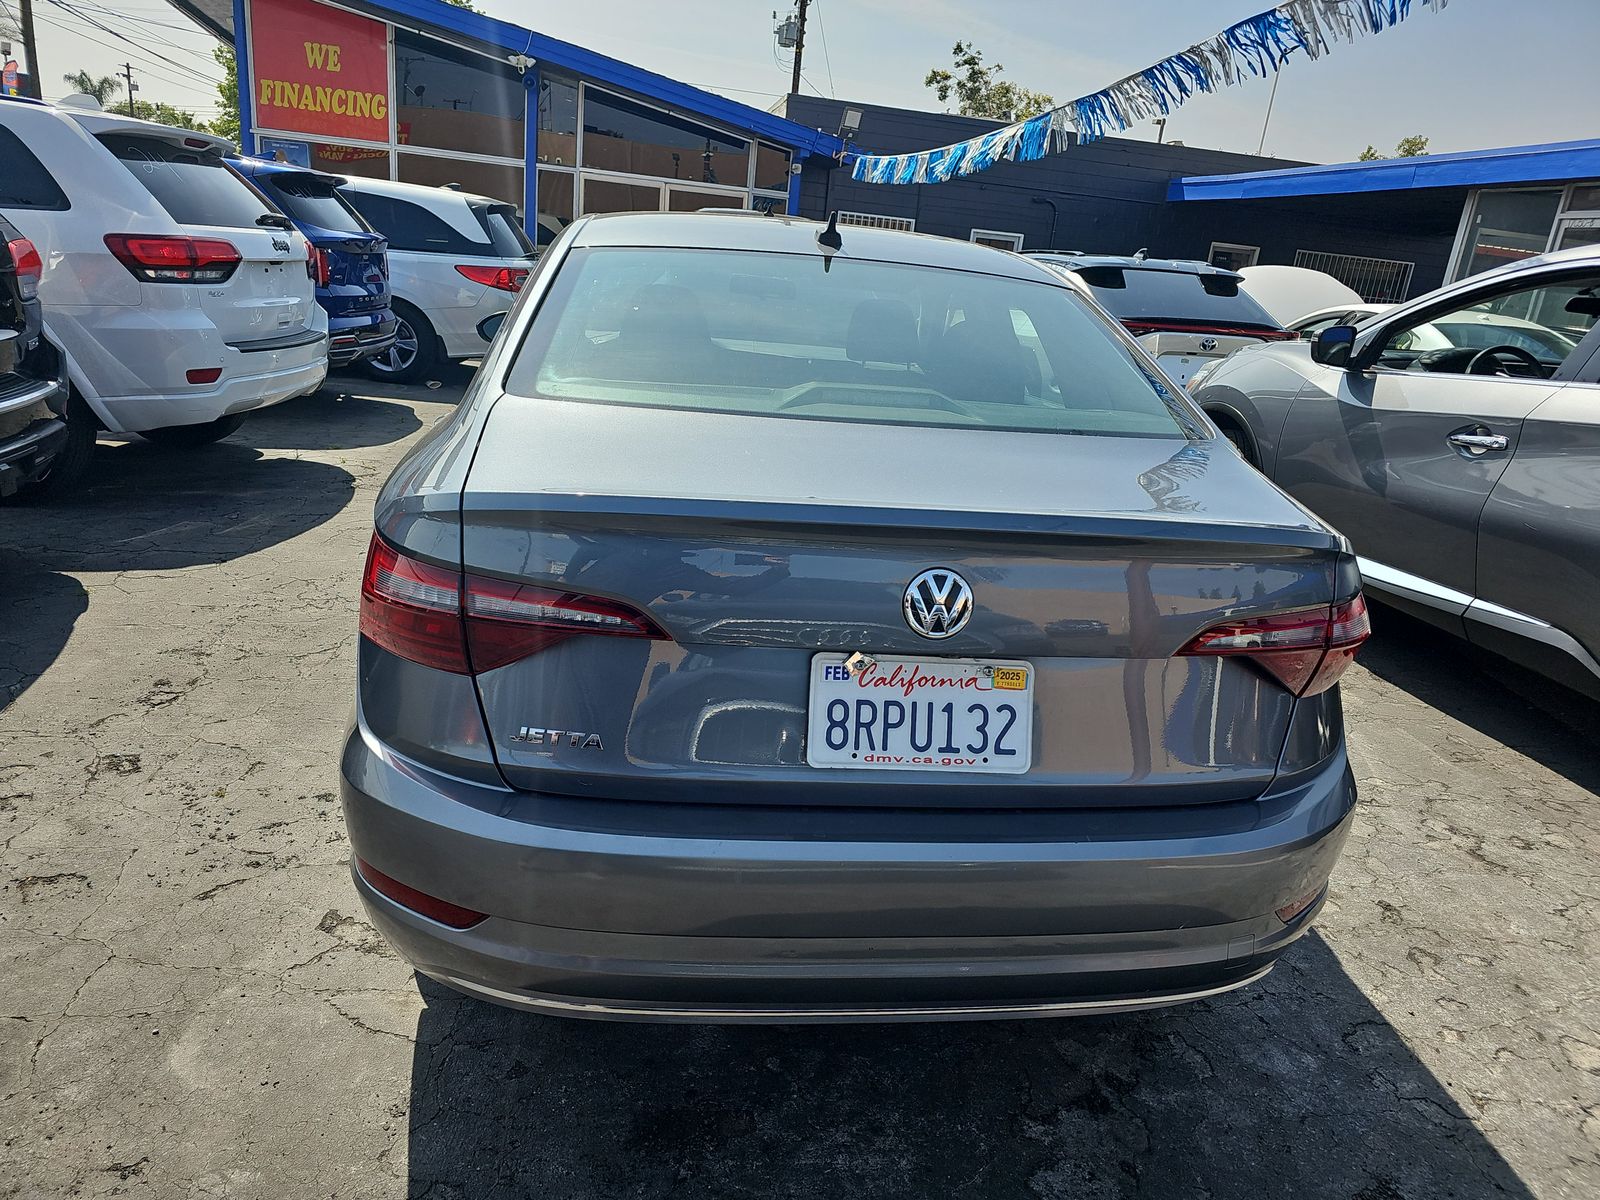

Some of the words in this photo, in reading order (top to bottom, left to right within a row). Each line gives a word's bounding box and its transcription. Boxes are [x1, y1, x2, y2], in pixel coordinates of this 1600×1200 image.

[304, 42, 341, 72] WE
[260, 79, 387, 120] FINANCING
[271, 236, 291, 254] Jeep
[905, 570, 974, 638] VW
[824, 665, 850, 681] FEB
[858, 663, 993, 697] California
[1000, 671, 1021, 681] 2025
[509, 726, 604, 750] JETTA
[825, 698, 1017, 756] 8RPU132
[864, 754, 977, 766] dmv.ca.gov
